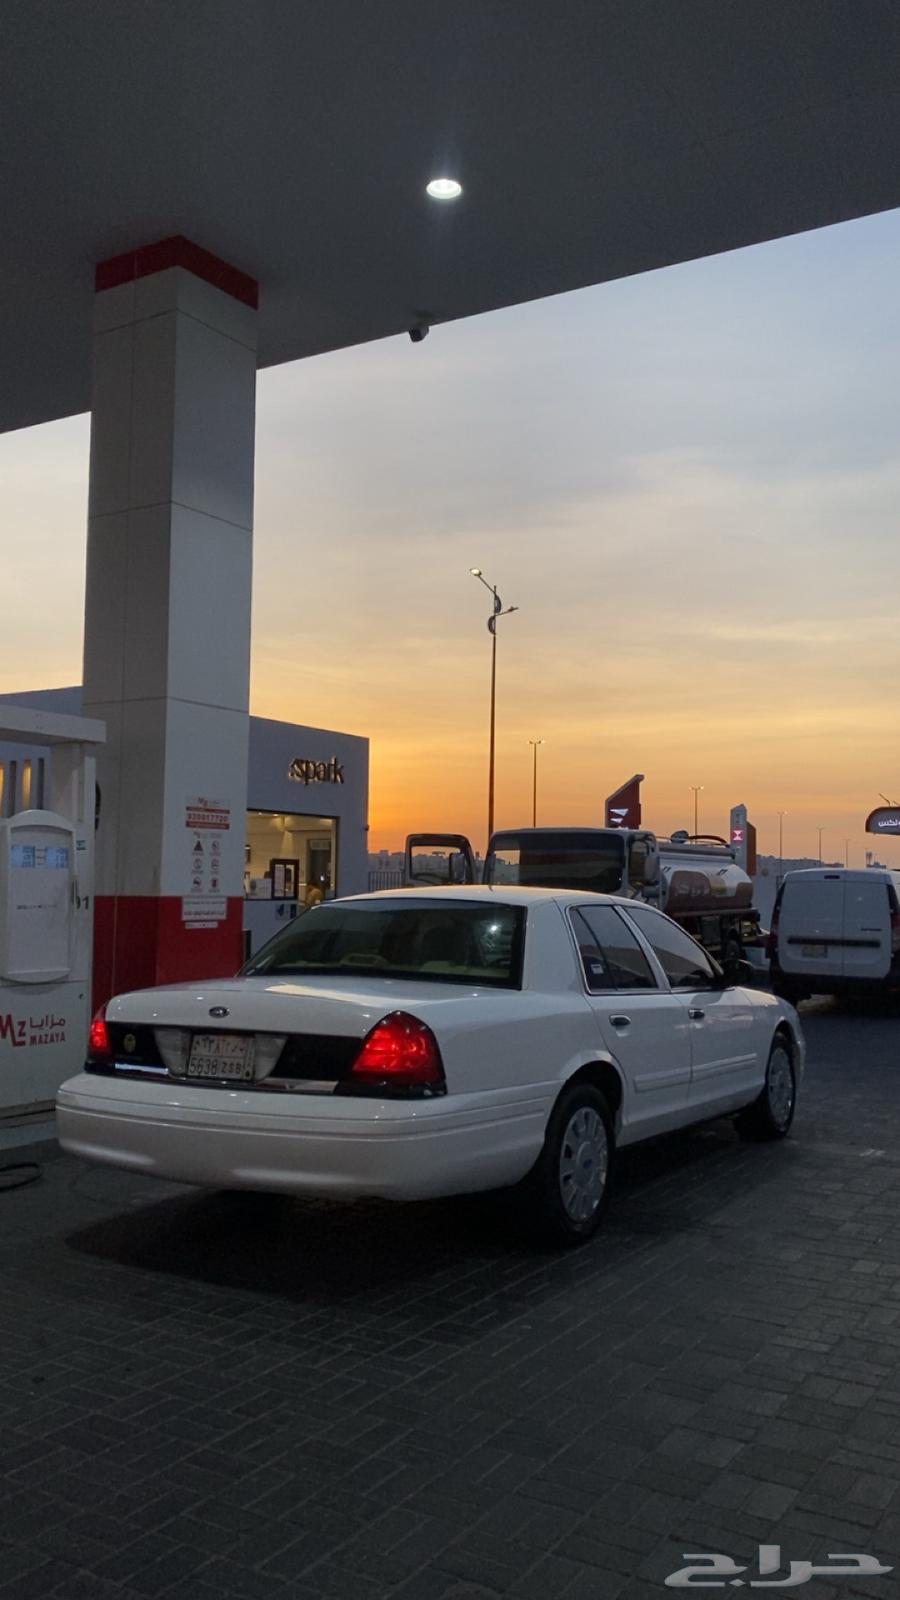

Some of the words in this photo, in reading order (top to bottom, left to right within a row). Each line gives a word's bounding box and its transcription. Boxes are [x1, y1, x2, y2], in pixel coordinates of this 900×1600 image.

[290, 757, 344, 785] spark
[30, 1031, 66, 1046] MAZAYA
[189, 1056, 217, 1075] 5638
